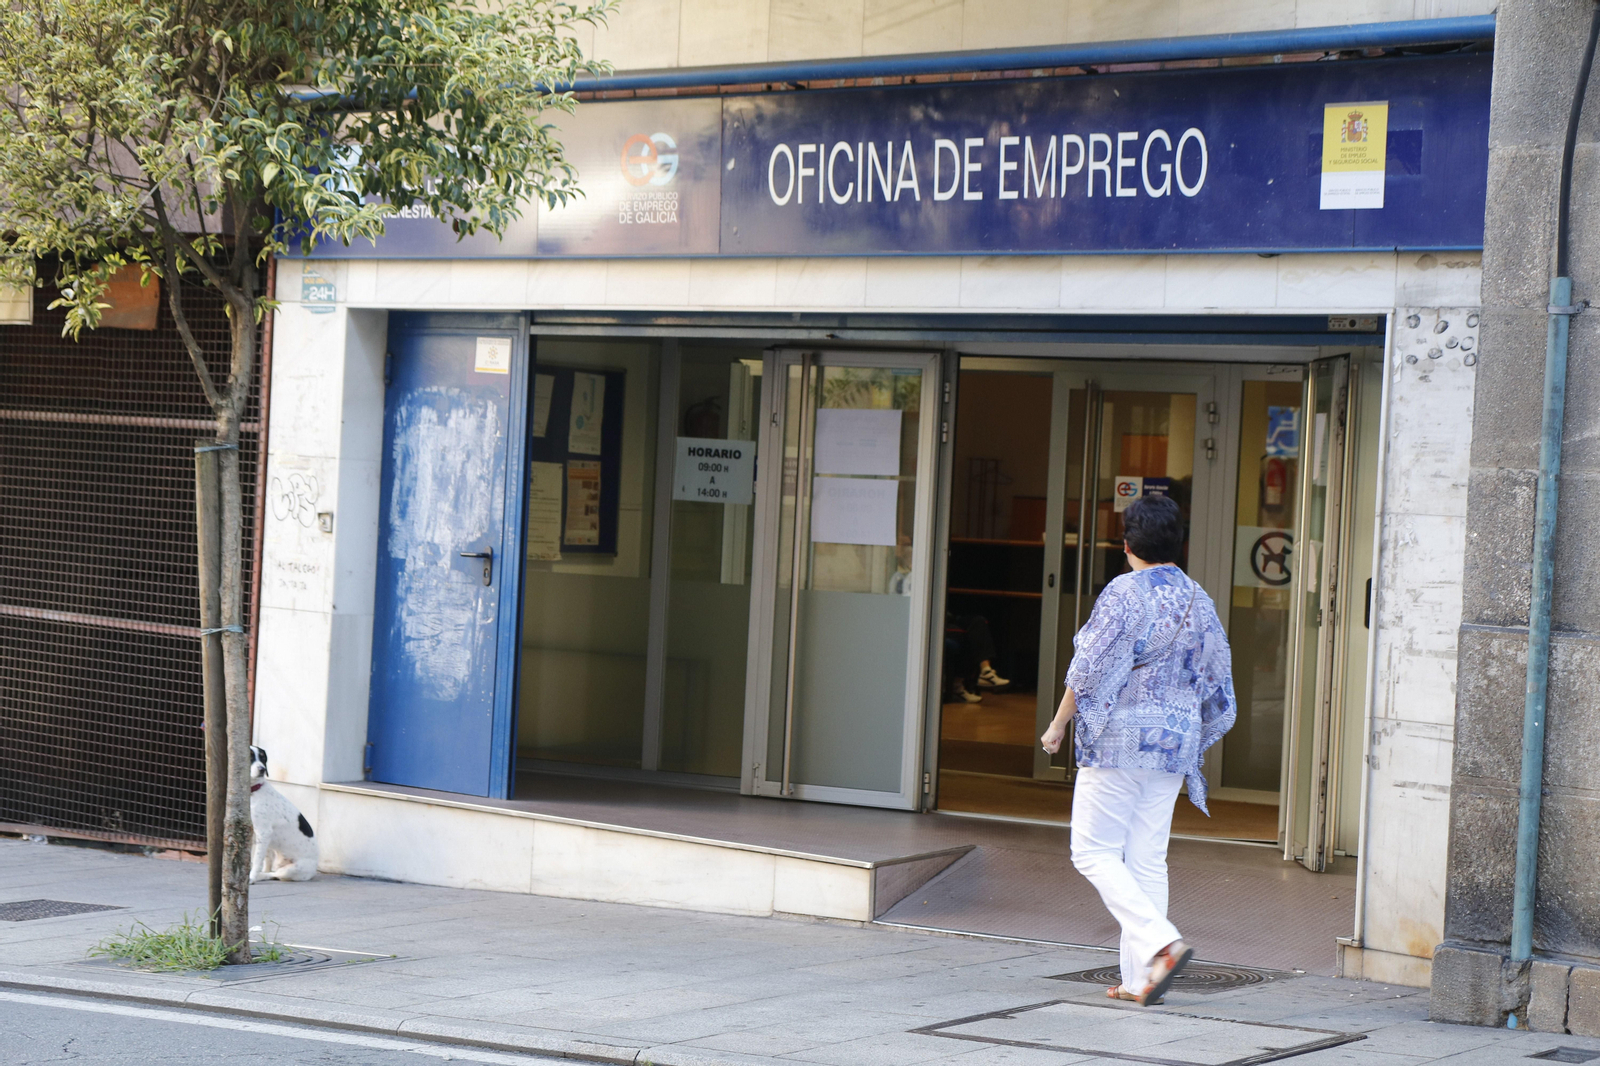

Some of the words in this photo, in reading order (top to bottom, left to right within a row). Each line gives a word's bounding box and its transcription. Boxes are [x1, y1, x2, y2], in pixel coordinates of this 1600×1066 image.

[768, 140, 921, 206] OFICINA
[934, 138, 984, 201] DE
[998, 127, 1208, 200] EMPREGO
[618, 192, 648, 201] RVIZO
[619, 200, 632, 212] DE
[633, 200, 679, 212] EMPREGO
[619, 211, 633, 224] DE
[635, 211, 678, 224] GALICIA
[308, 286, 335, 301] 24H
[688, 447, 742, 460] HORARIO
[698, 462, 722, 473] 09:00
[723, 465, 729, 473] H
[709, 476, 715, 485] A
[697, 488, 720, 498] 14:00
